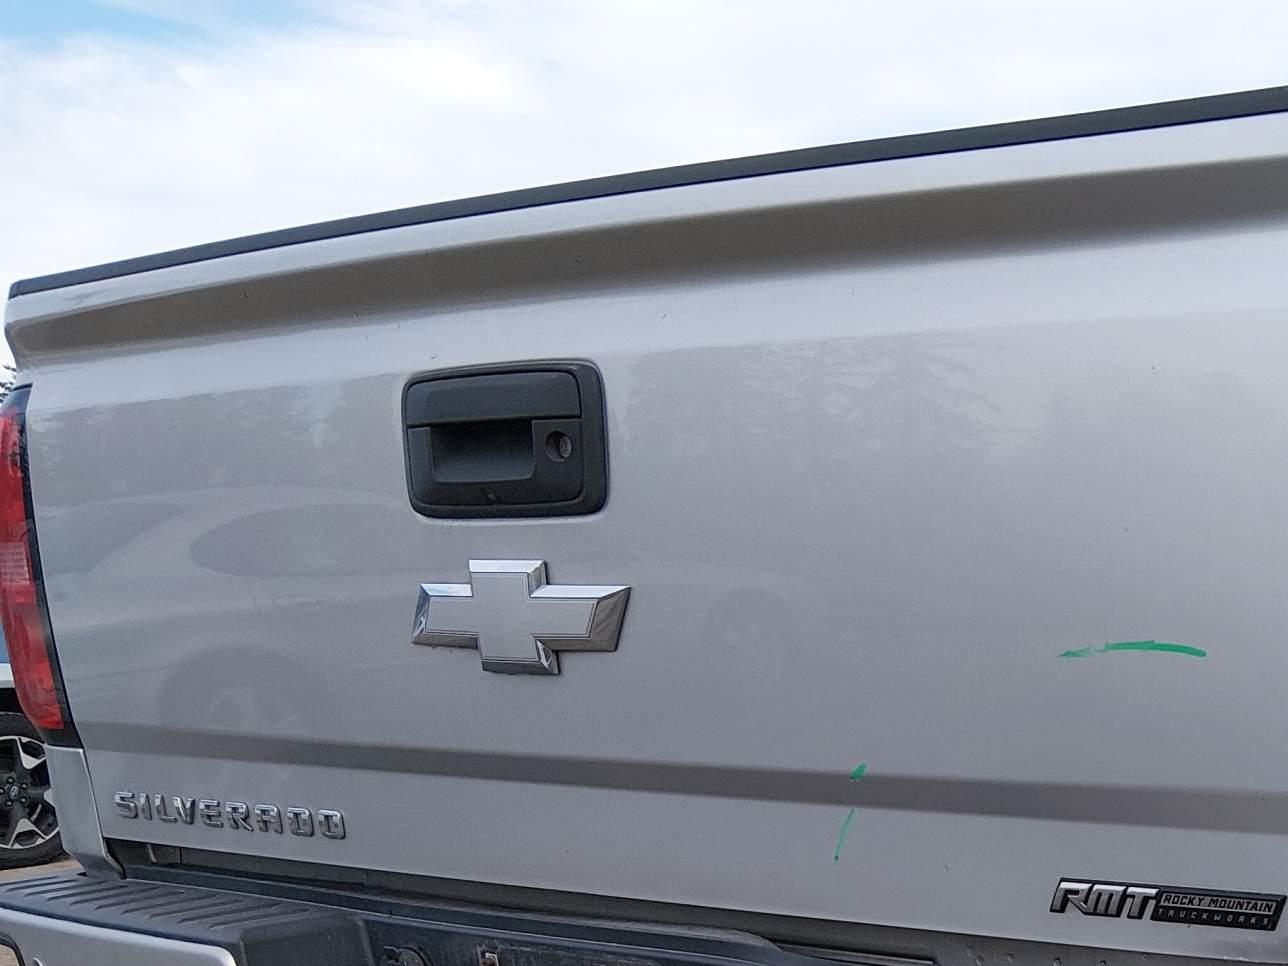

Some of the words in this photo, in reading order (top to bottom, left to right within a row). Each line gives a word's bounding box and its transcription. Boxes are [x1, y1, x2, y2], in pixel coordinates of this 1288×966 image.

[114, 790, 346, 840] SILVERADO
[1051, 879, 1161, 920] RMT
[1162, 893, 1206, 908] ROCKY
[1208, 896, 1275, 914] MOUNTAIN
[1157, 907, 1270, 927] TRUCKWORKS
